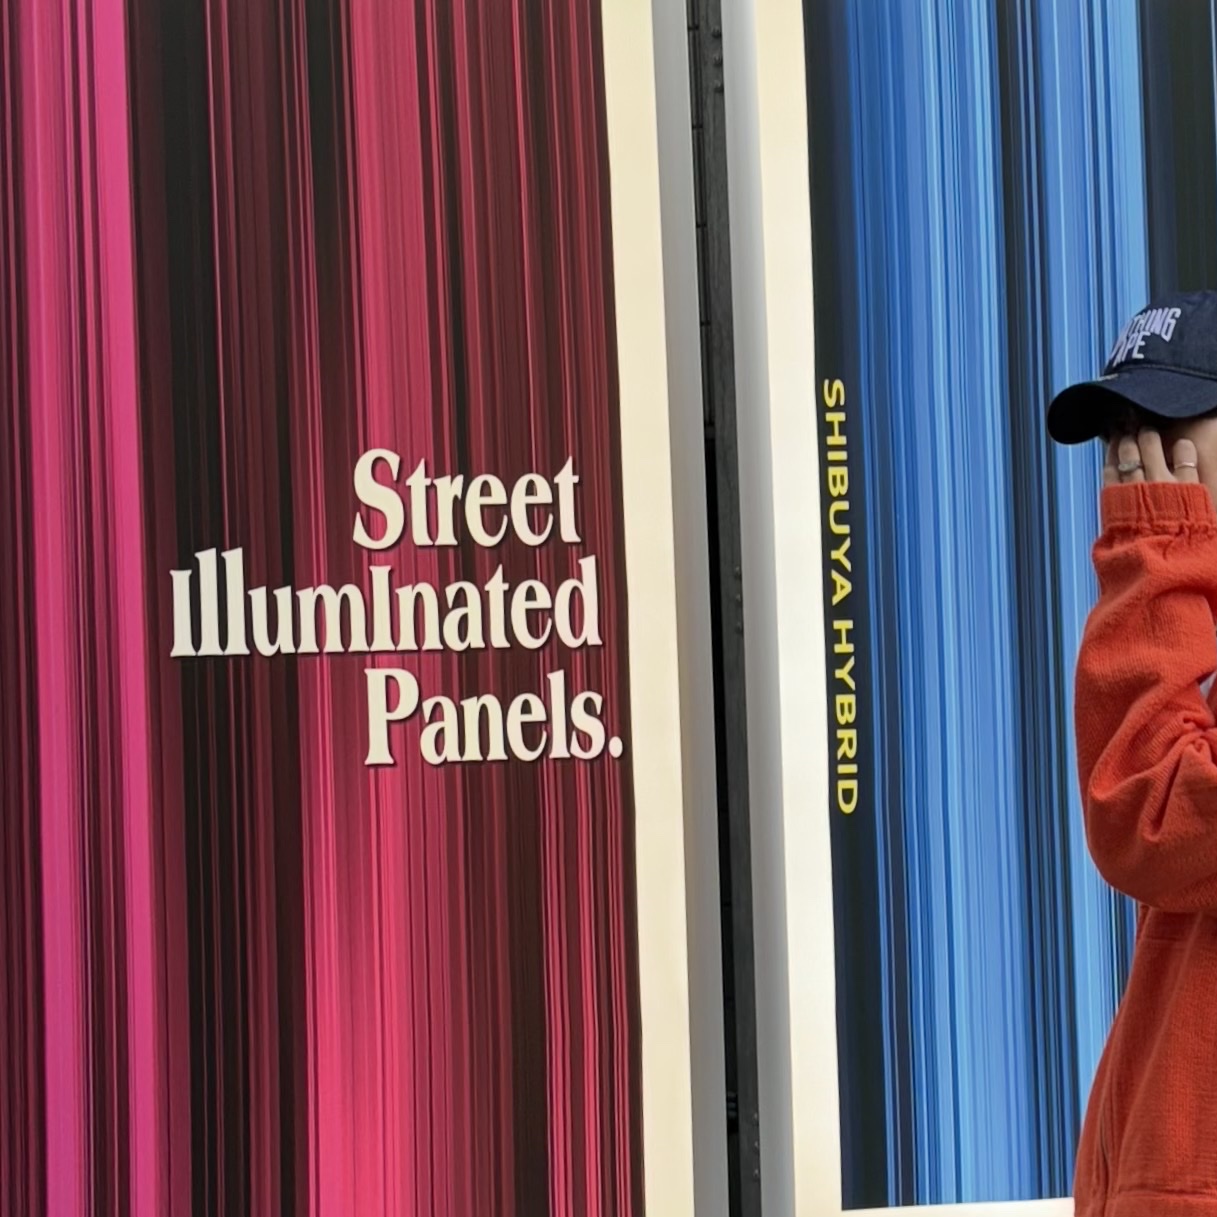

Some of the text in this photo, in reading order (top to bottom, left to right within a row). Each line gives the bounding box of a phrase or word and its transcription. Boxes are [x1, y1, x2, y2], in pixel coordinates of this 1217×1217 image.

[352, 447, 581, 550] Street
[823, 379, 859, 815] SHIBUYA HYBRID
[364, 667, 623, 766] Panels.
